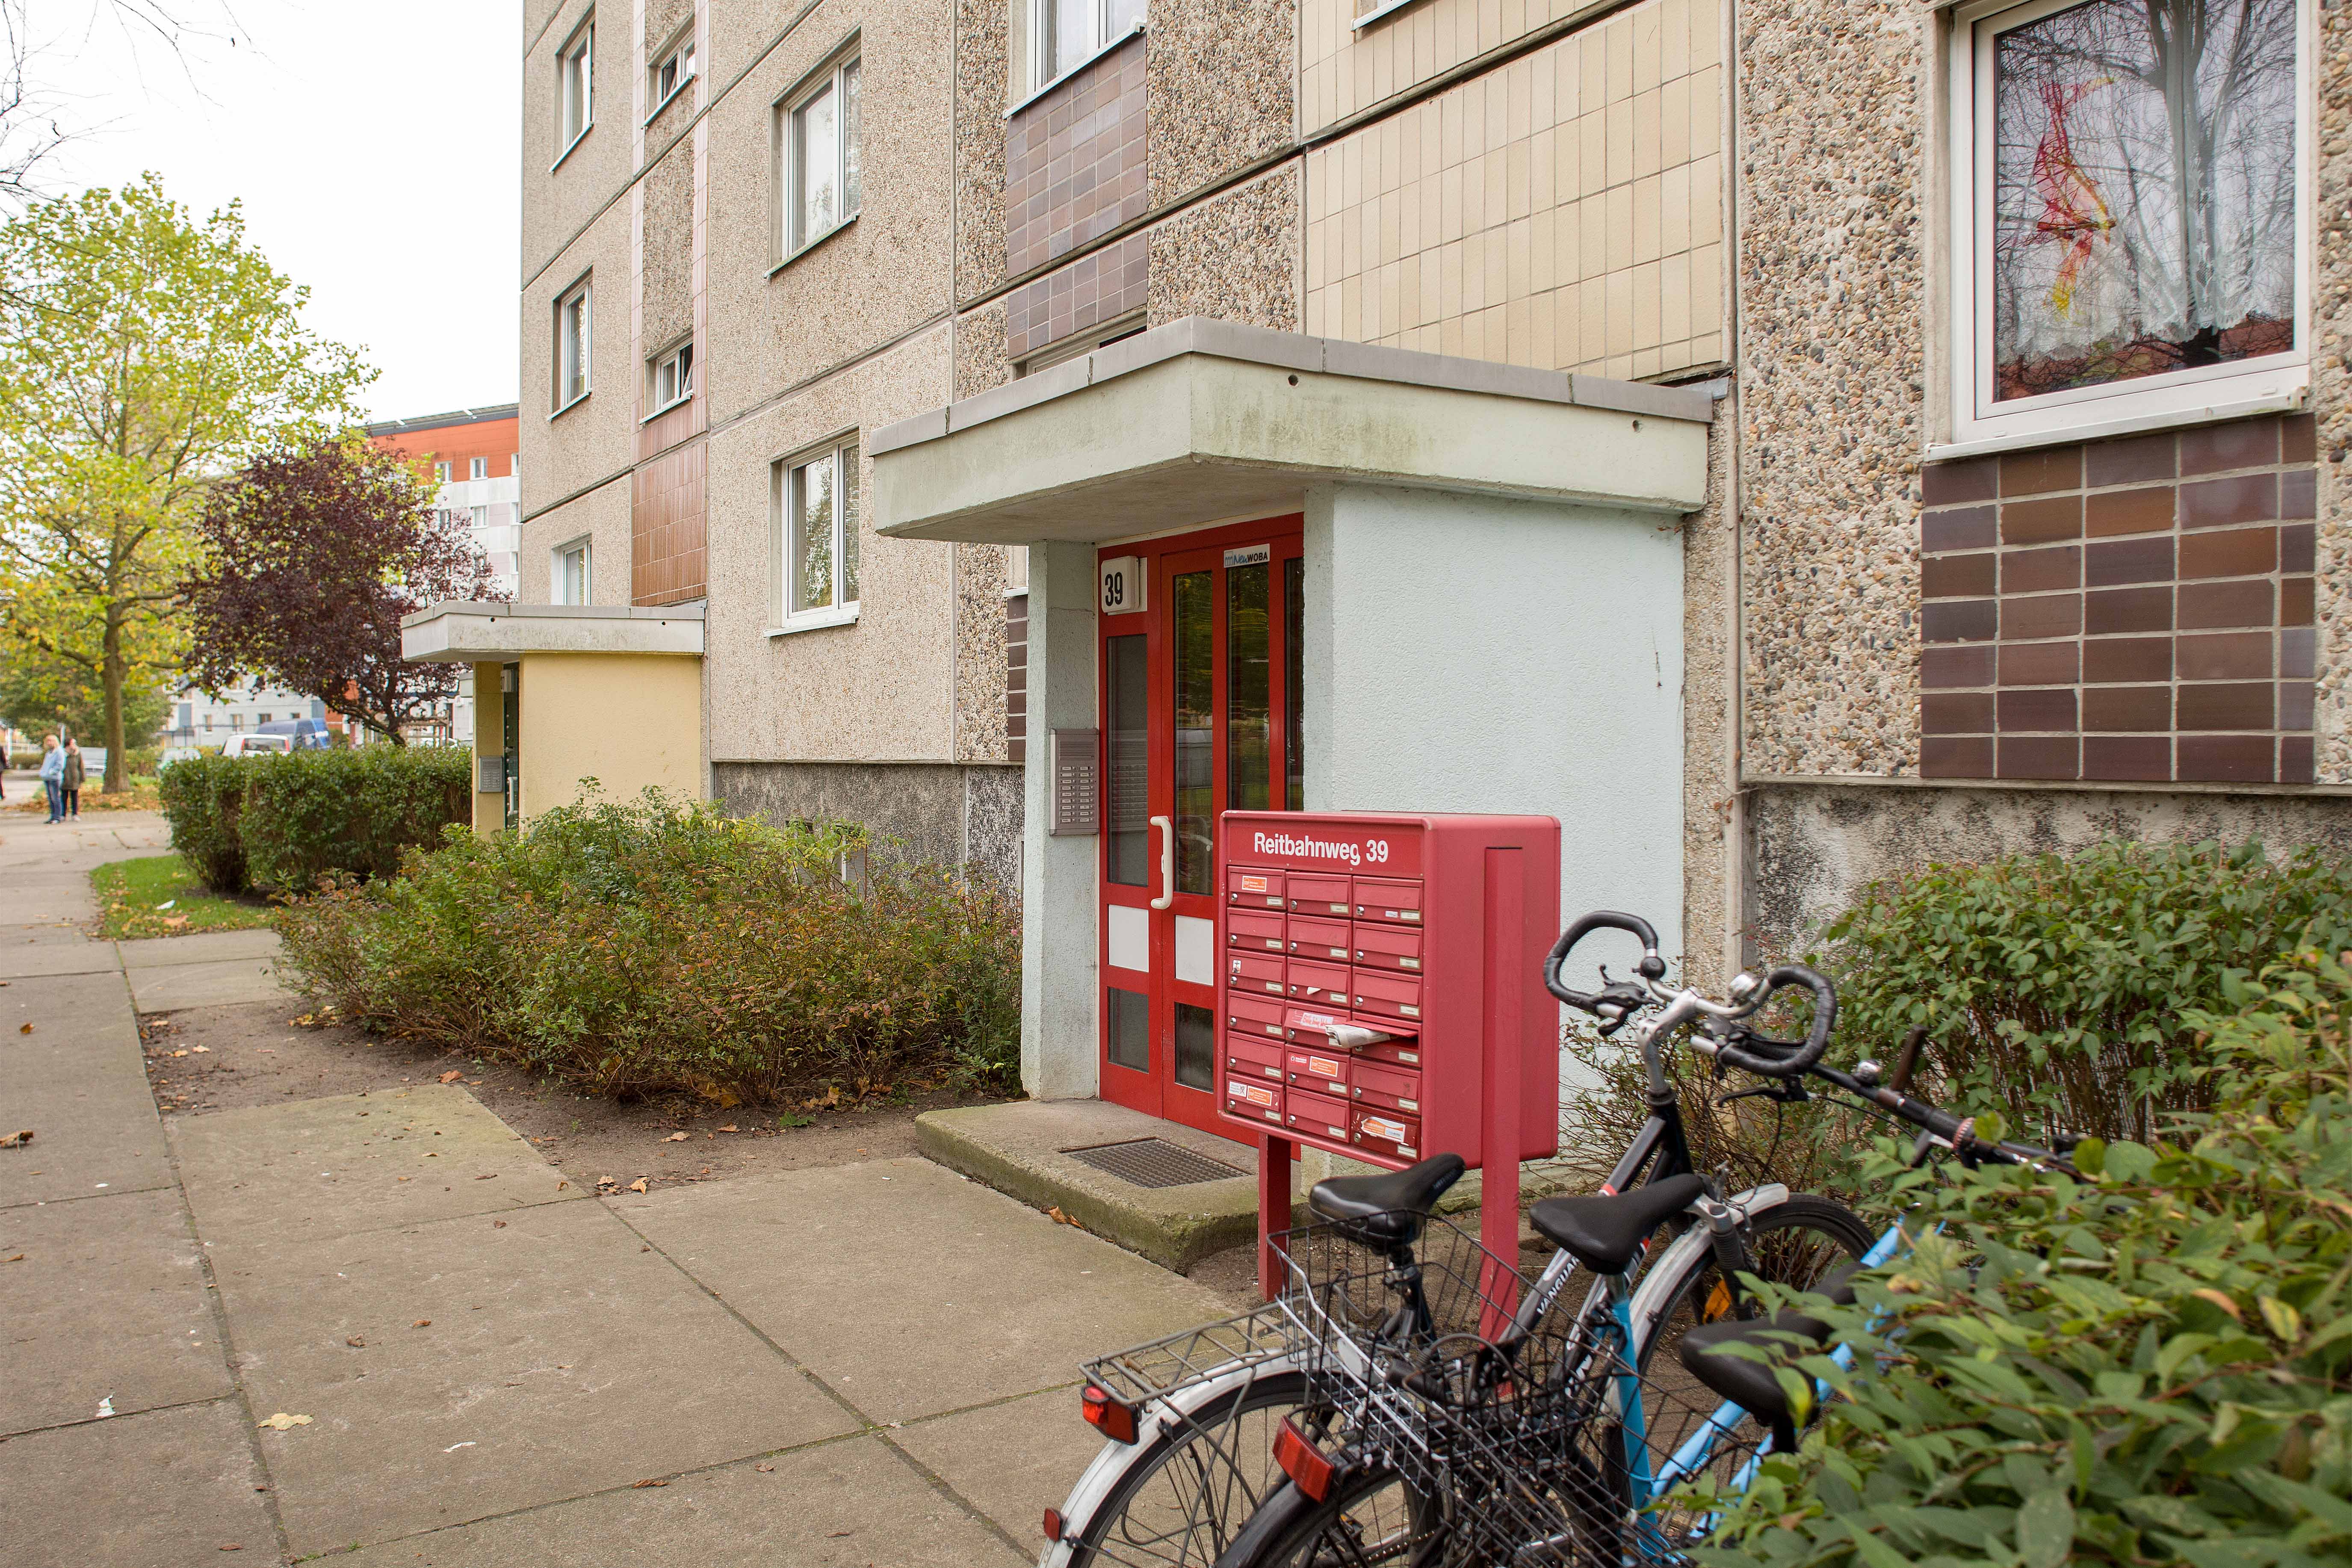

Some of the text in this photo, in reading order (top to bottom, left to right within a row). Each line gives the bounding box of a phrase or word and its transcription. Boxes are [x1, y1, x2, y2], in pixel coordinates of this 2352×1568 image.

[1233, 551, 1268, 565] NeuWOBA
[1105, 572, 1123, 606] 39
[1254, 832, 1389, 865] Reitbahnweg 39
